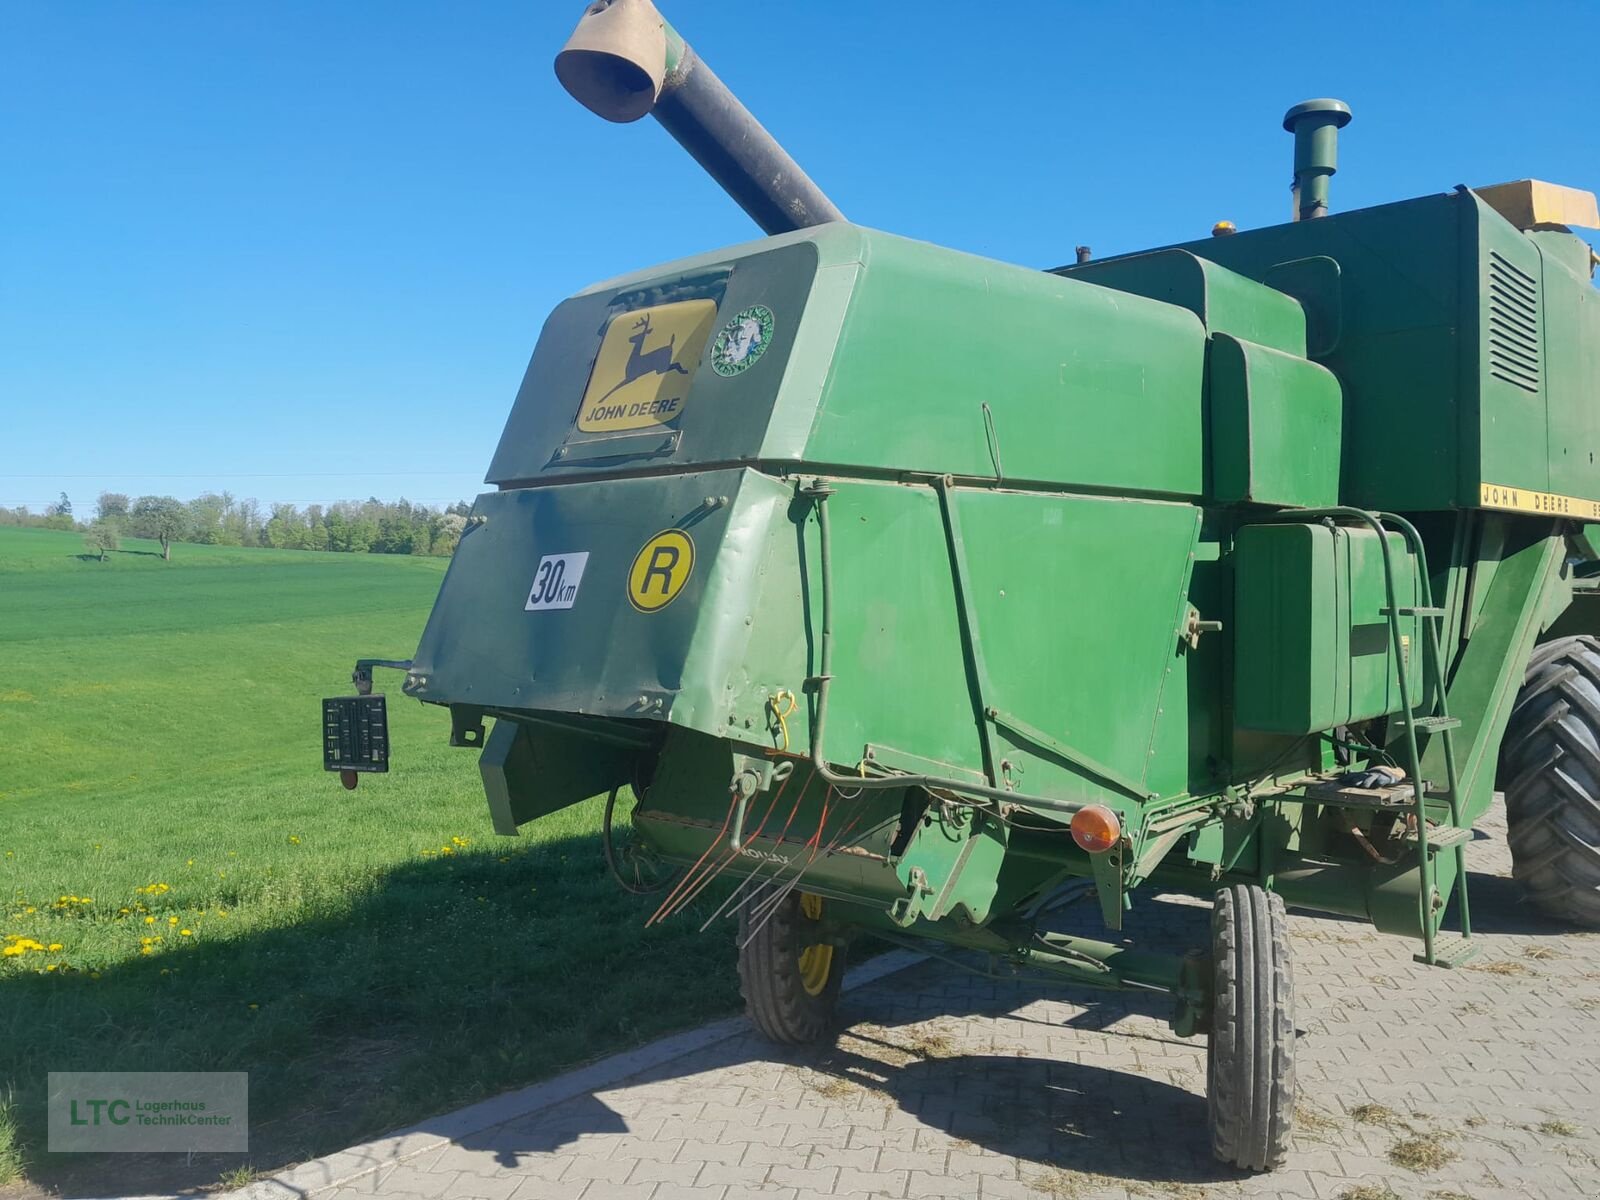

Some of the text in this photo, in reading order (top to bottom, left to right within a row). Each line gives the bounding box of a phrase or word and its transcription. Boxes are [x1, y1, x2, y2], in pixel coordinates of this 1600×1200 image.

[585, 397, 681, 422] JOHN DEERE
[1483, 486, 1518, 507] JOHN
[1535, 494, 1569, 513] DEERE
[640, 546, 680, 595] R
